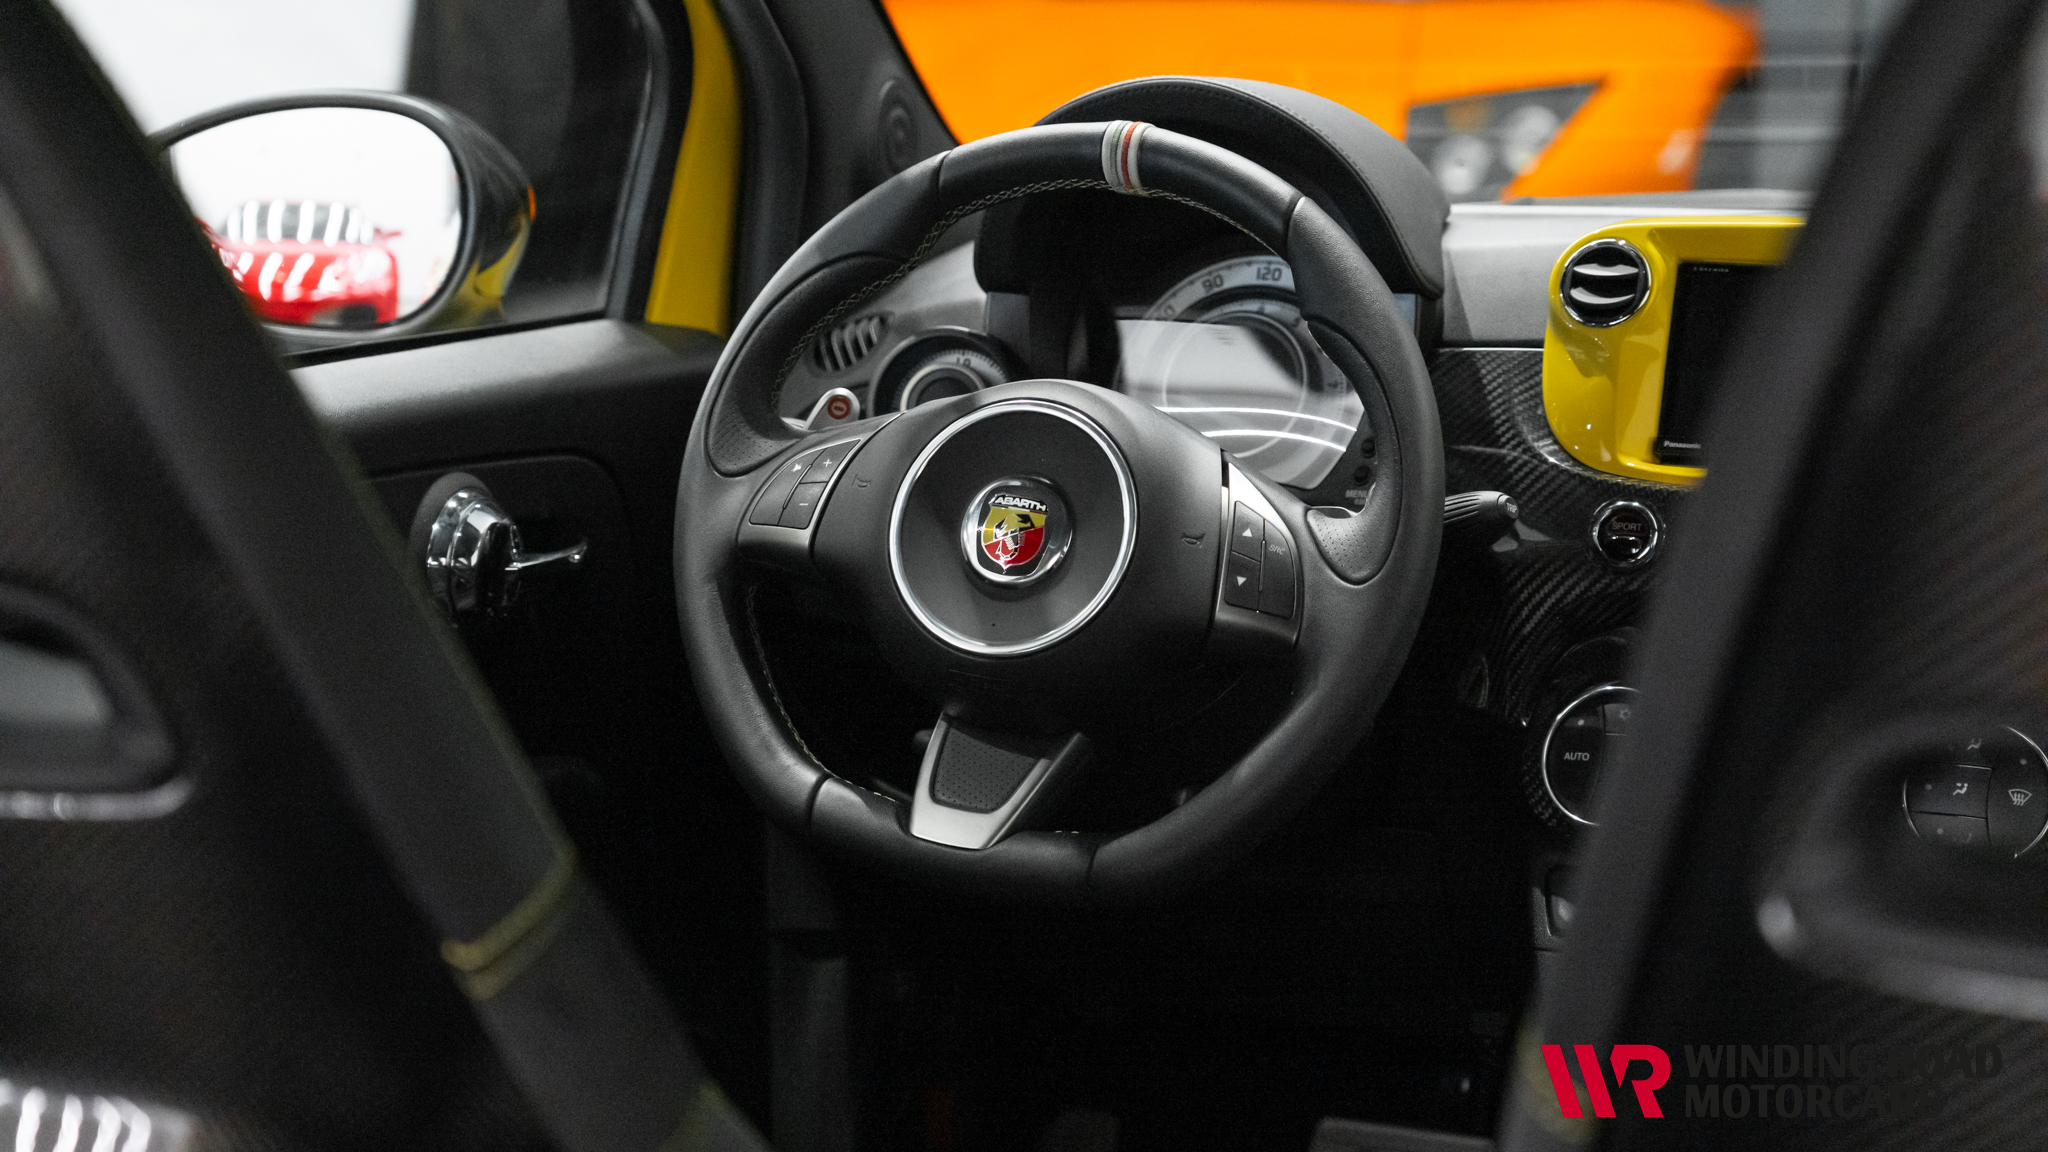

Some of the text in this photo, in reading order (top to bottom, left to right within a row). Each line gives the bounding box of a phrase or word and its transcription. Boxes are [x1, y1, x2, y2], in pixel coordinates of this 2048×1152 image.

[1256, 267, 1282, 281] 120
[1202, 275, 1224, 292] 90
[1664, 440, 1702, 449] Panasonic
[995, 496, 1047, 511] ABARTH
[1506, 502, 1517, 513] TRIP
[1612, 521, 1642, 531] SPORT
[1269, 544, 1285, 555] SRC
[1564, 752, 1590, 761] AUTO
